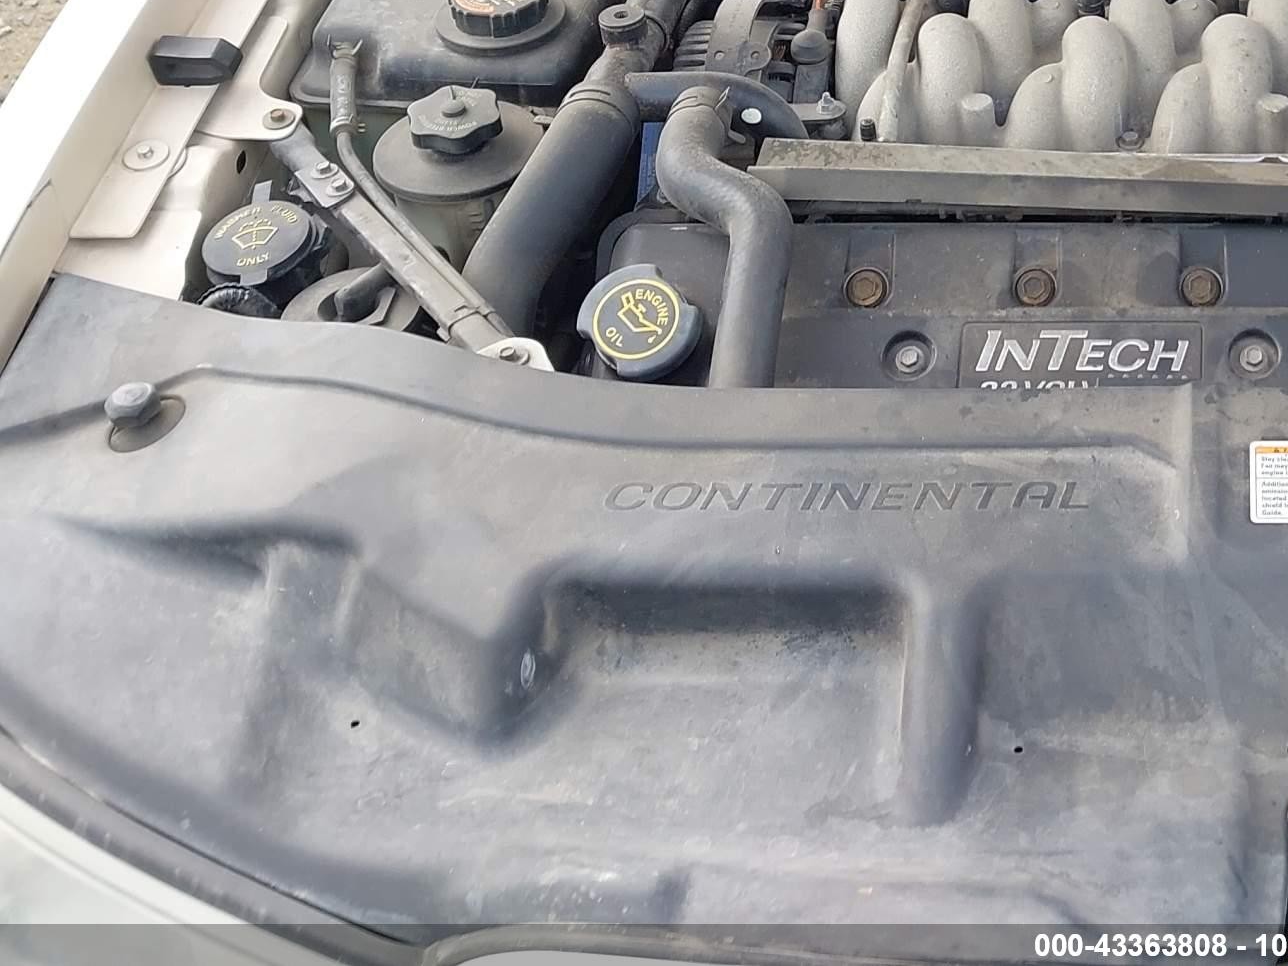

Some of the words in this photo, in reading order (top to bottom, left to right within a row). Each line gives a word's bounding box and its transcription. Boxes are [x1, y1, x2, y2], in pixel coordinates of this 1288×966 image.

[214, 207, 261, 240] WASHER
[270, 204, 298, 226] FLUID
[236, 252, 269, 266] ONLY
[635, 288, 670, 326] ENGINE
[606, 326, 624, 348] OIL
[604, 481, 1089, 510] CONTINENTAL
